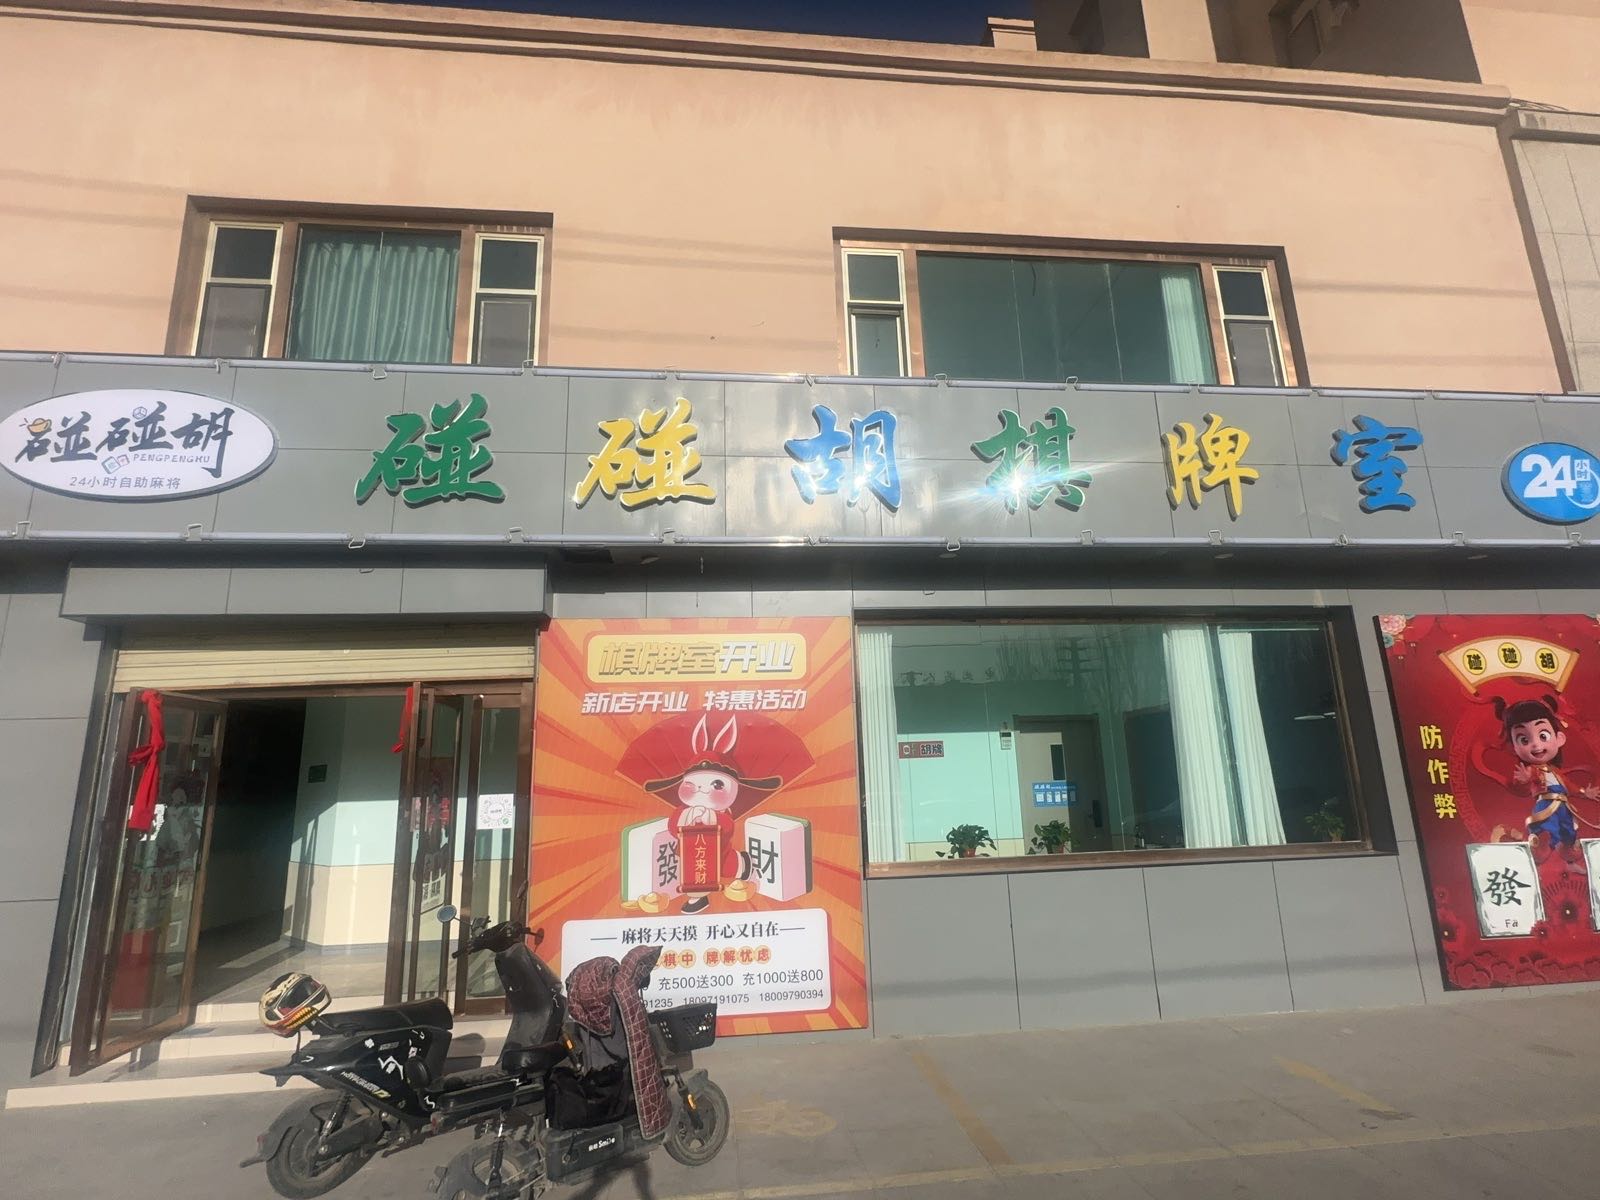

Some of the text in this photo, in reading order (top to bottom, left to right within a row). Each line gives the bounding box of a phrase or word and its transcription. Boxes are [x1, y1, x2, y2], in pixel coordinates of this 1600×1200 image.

[15, 401, 235, 479] 碰碰胡
[133, 453, 211, 464] PENGPENGHU
[69, 476, 181, 490] 24小时自助麻将
[598, 640, 796, 675] 棋牌室开业
[581, 688, 807, 714] 新店开业 特惠活动
[1419, 724, 1457, 819] 防作弊
[656, 841, 678, 887] 發
[695, 833, 706, 884] 八方来财
[748, 836, 779, 884] 財
[1483, 867, 1531, 906] 發
[621, 920, 780, 944] 麻将天天摸 开心又自在
[653, 947, 771, 967] 棋中 牌解忧虑
[659, 974, 734, 991] 充500送300
[743, 969, 824, 986] 充1000送800
[760, 989, 824, 1002] 18009790394
